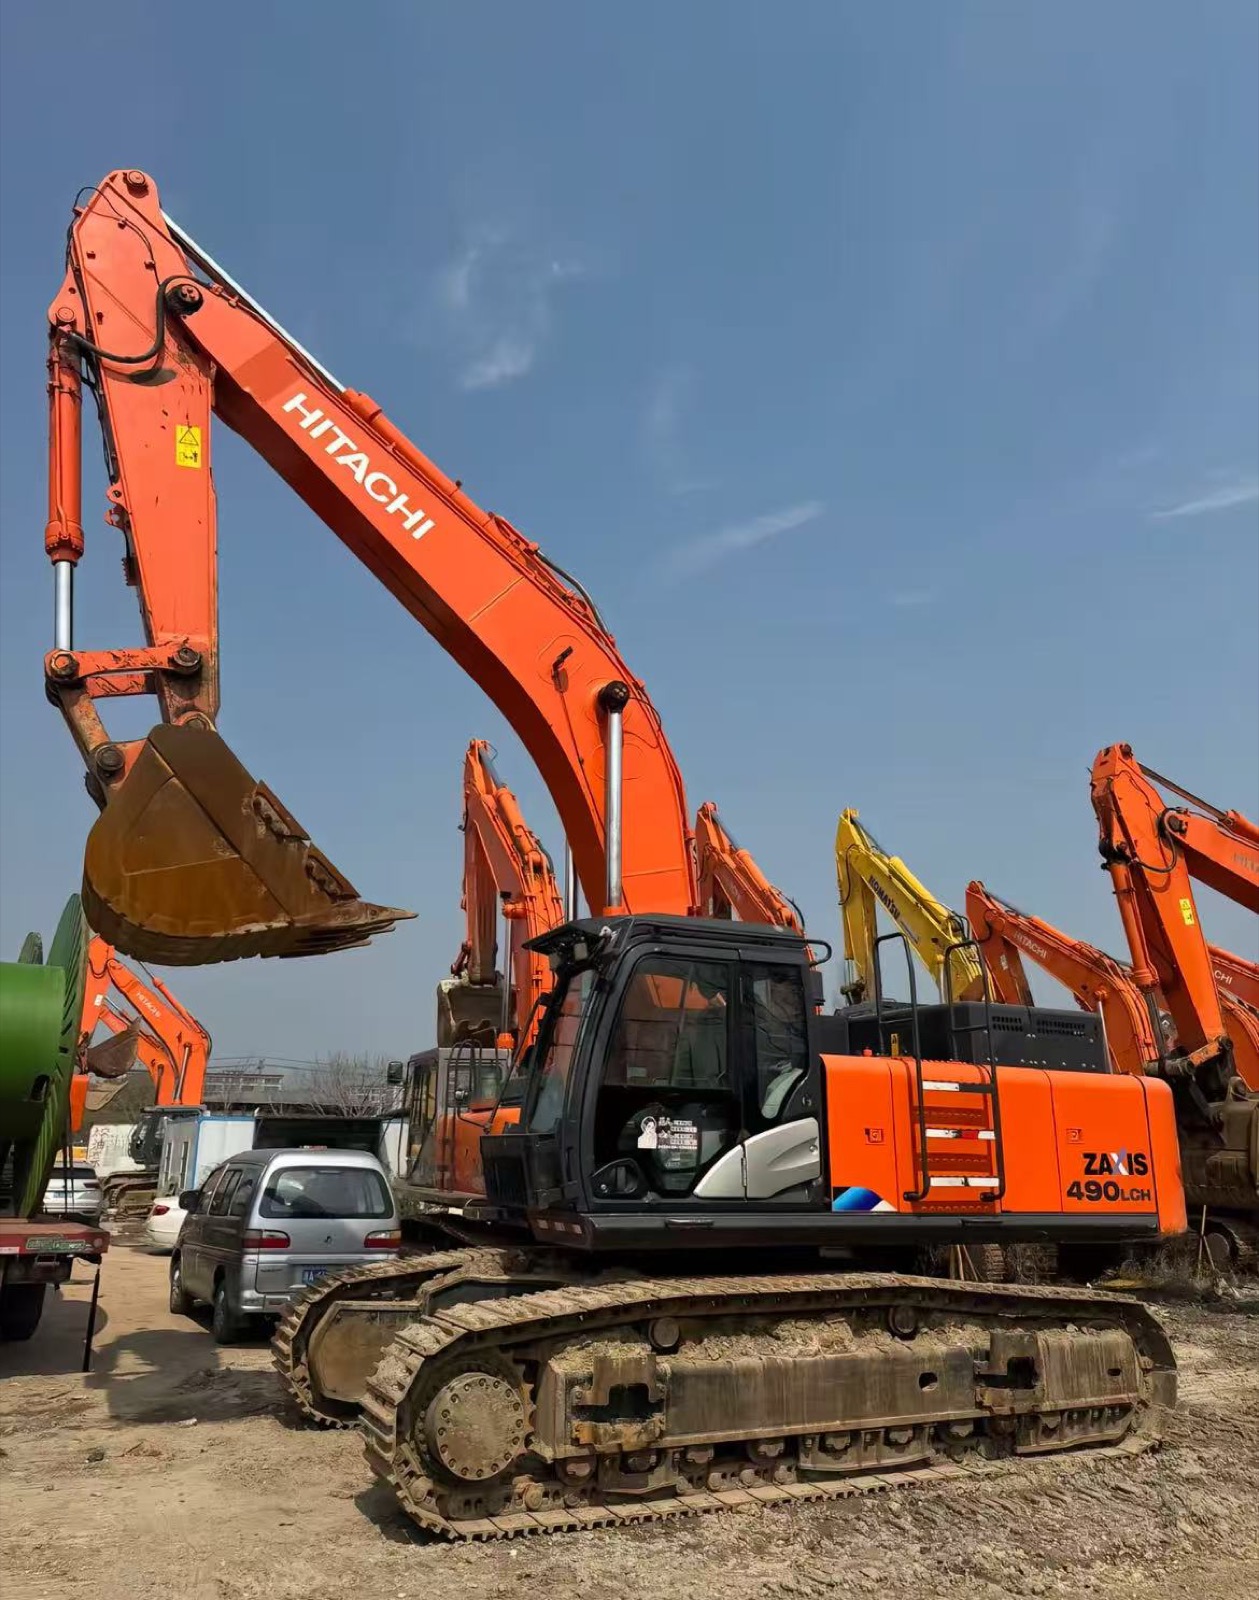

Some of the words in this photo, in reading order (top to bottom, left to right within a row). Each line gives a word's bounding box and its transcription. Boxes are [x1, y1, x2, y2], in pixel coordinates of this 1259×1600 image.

[282, 392, 436, 541] HITACHI
[868, 874, 901, 920] KOMATSU
[1014, 930, 1048, 960] HITACHI
[1083, 1147, 1149, 1176] ZAXIS
[1066, 1180, 1151, 1202] 490LCH
